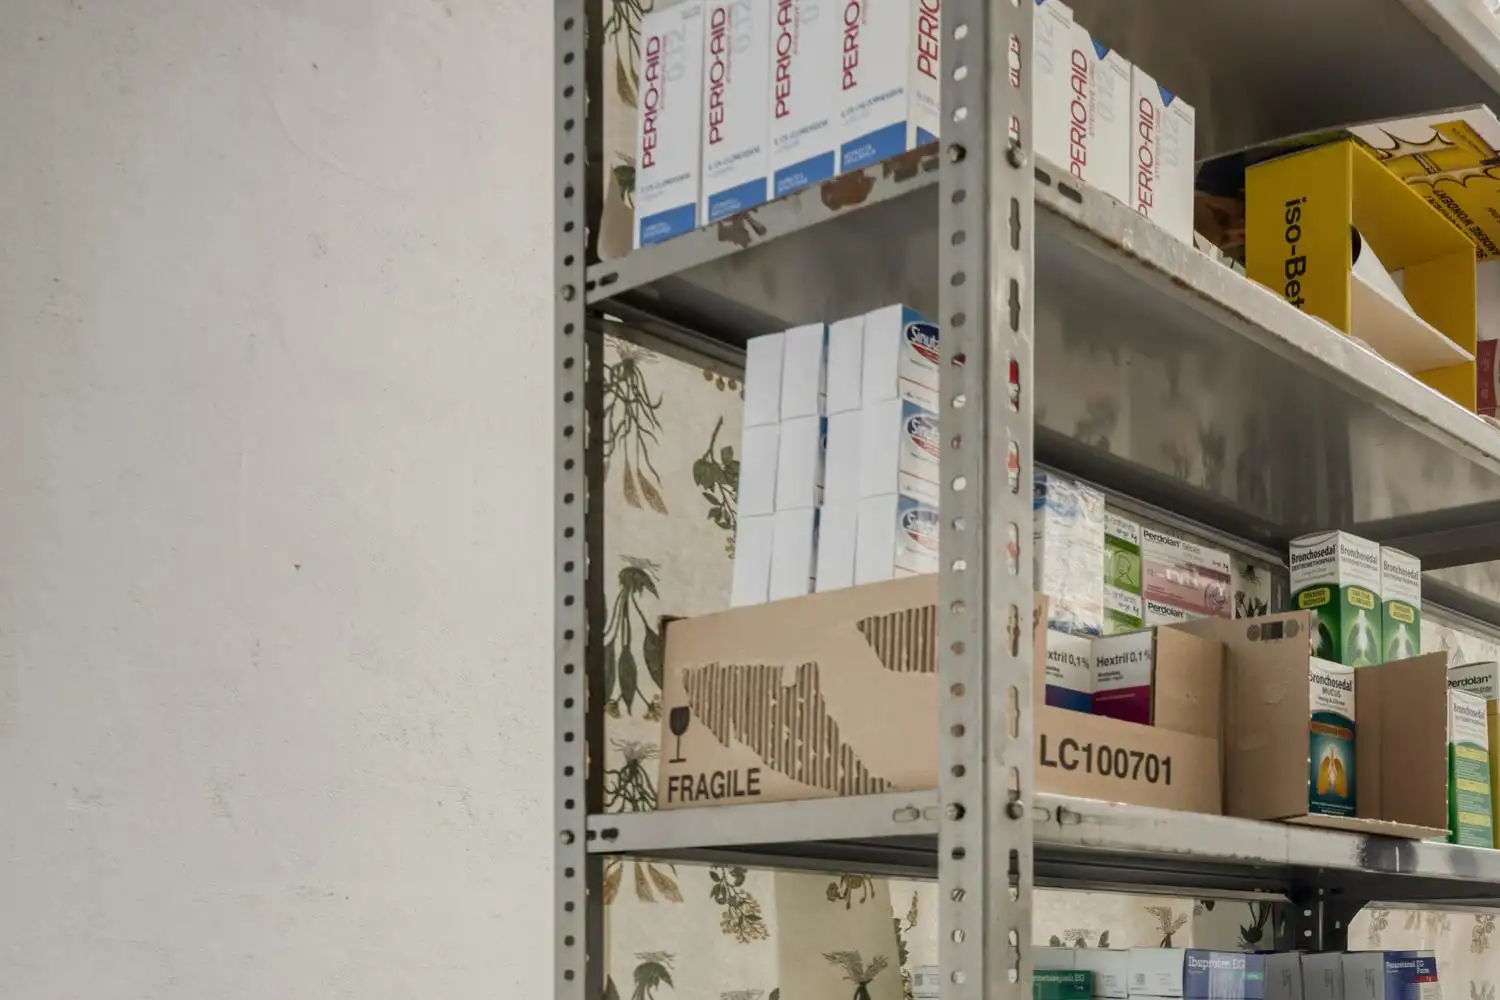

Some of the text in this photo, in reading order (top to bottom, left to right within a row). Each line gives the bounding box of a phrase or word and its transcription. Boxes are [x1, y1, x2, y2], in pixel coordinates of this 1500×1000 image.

[709, 7, 726, 145] PERIO-AID
[775, 0, 792, 119] PERIO-AI
[842, 0, 860, 91] PERIO
[642, 35, 660, 169] PERIO-AID
[1070, 49, 1088, 182] PERIO-AID
[1048, 650, 1067, 664] xtril
[1096, 653, 1128, 668] Hextril
[668, 767, 762, 803] FRAGILE
[1039, 733, 1173, 786] LC100701
[1188, 955, 1246, 970] Ibuprofen EG
